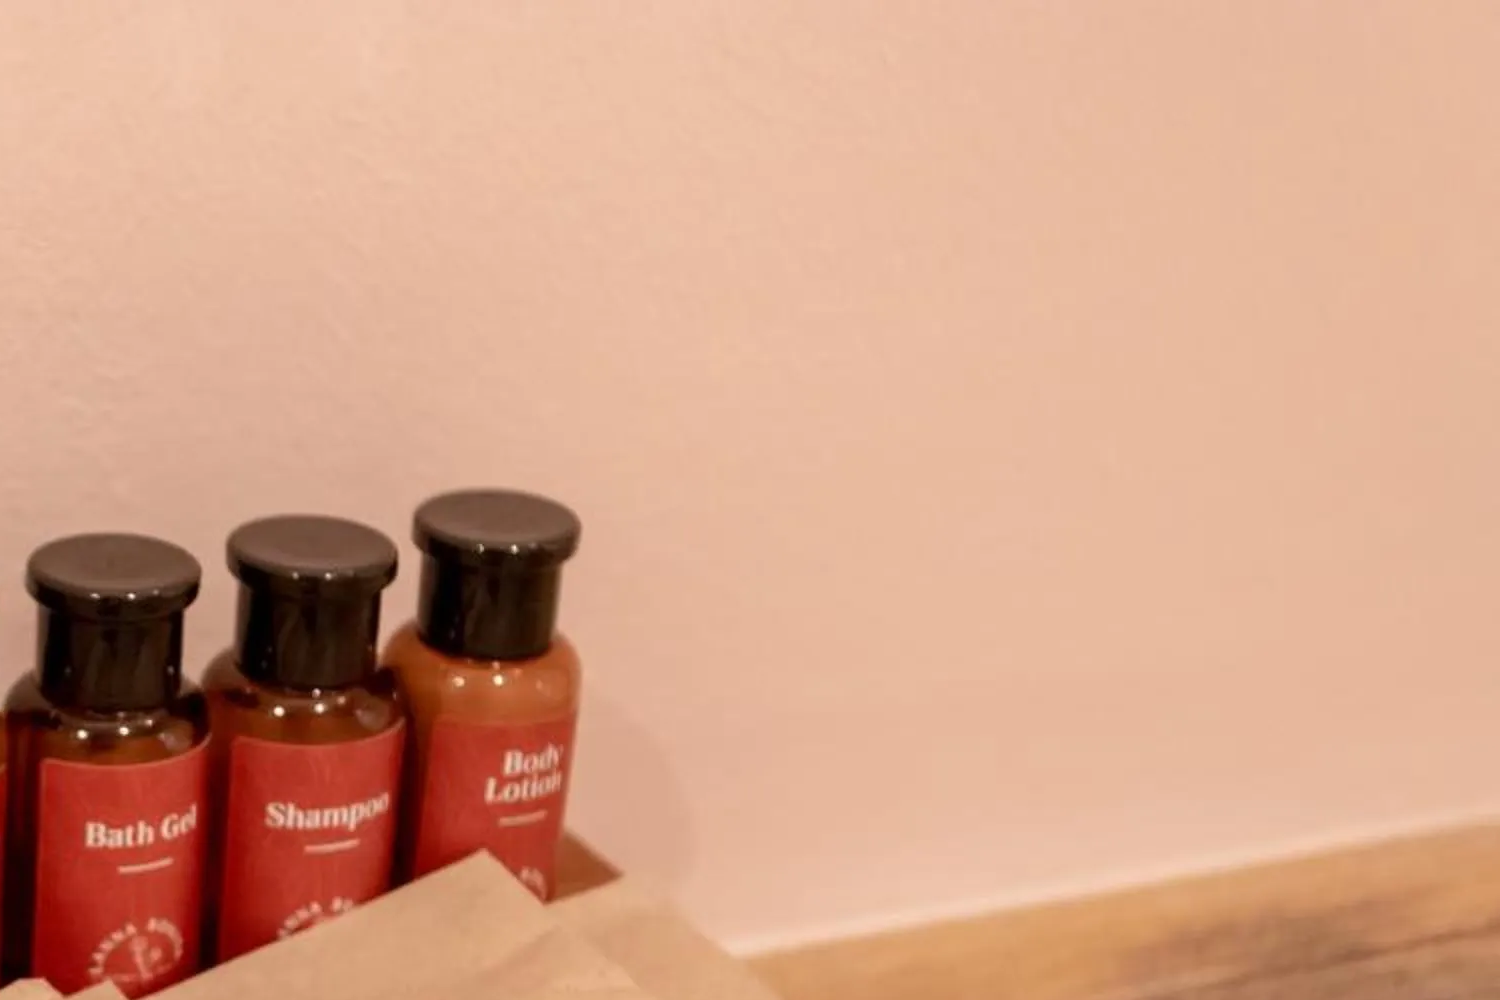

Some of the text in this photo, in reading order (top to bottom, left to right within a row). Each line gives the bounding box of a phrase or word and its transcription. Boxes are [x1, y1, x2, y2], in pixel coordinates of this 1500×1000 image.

[504, 743, 564, 776] Body
[485, 771, 563, 806] Lotion
[84, 804, 198, 848] Bath Gel
[264, 793, 390, 831] Shampoo
